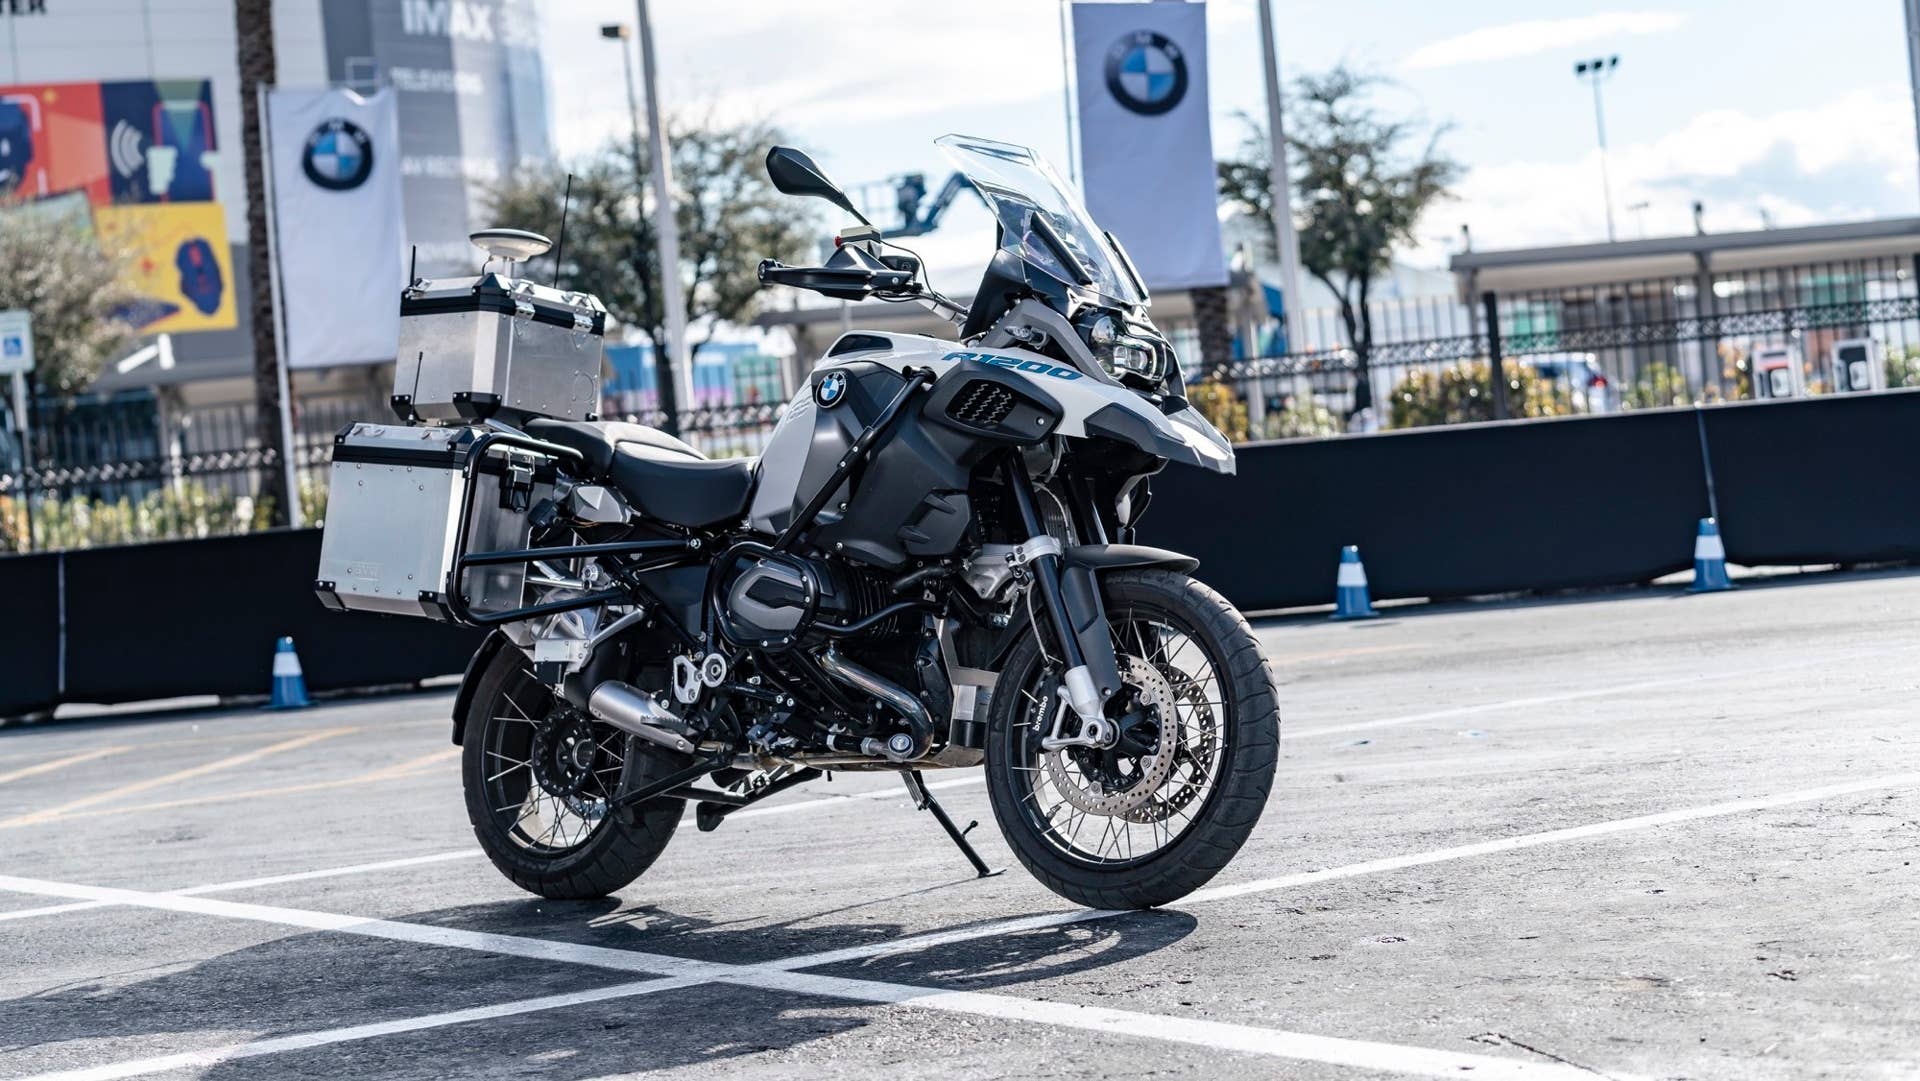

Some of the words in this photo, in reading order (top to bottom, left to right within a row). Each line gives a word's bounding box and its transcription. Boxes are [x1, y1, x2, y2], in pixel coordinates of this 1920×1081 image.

[402, 0, 495, 42] IMAX
[942, 351, 1084, 381] R1200
[1032, 696, 1048, 731] brembo
